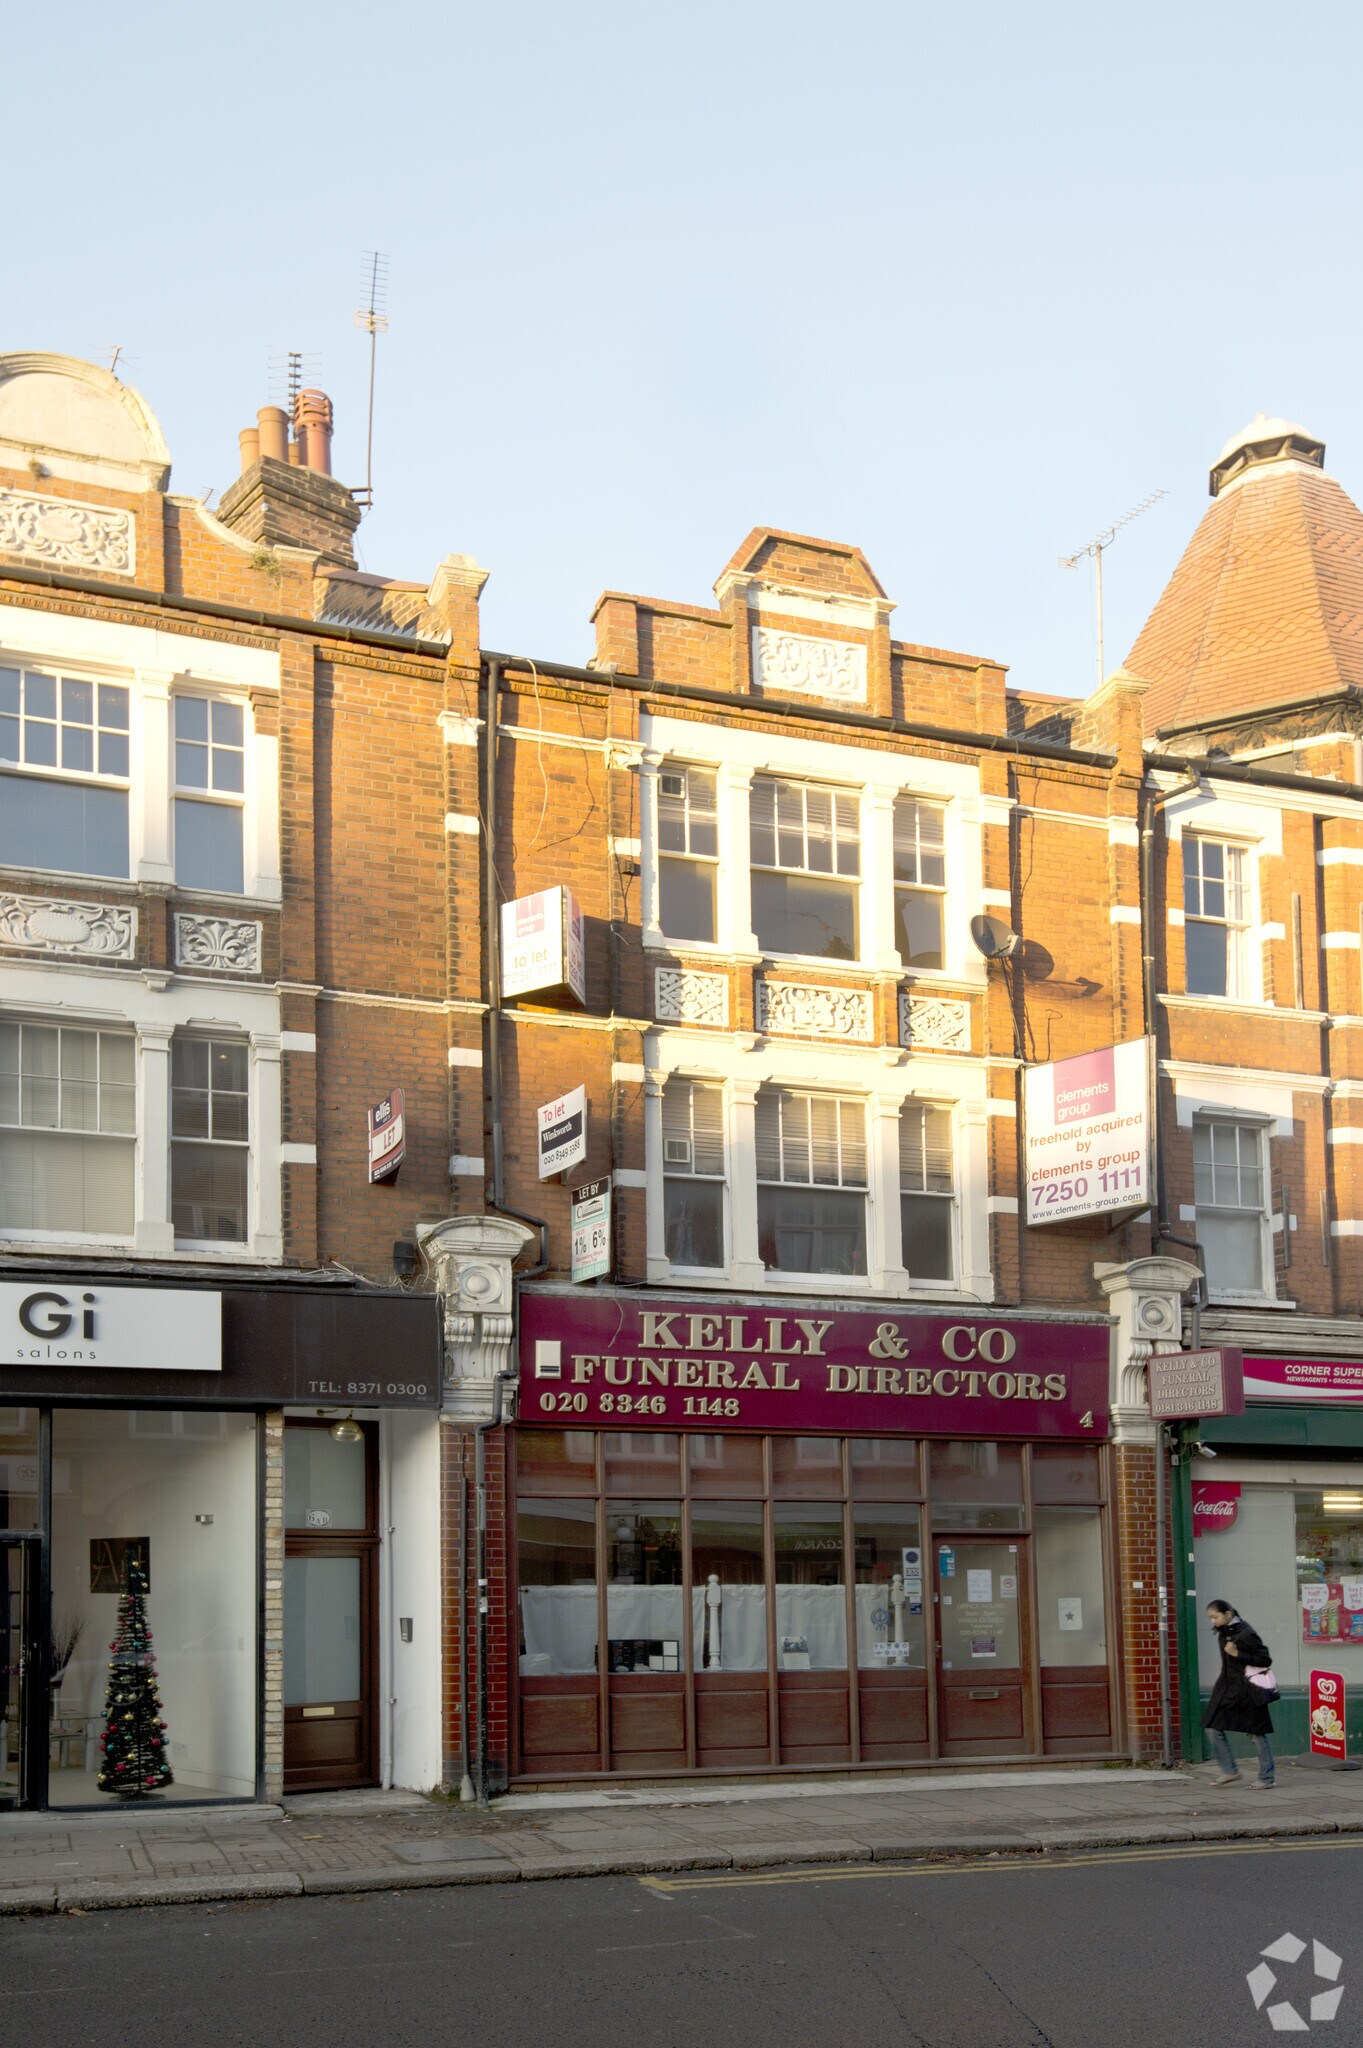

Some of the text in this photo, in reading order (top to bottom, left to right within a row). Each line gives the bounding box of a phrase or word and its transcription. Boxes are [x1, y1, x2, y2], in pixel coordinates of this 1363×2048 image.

[514, 948, 547, 968] to let
[1056, 1081, 1109, 1104] clements
[375, 1100, 391, 1123] ellis
[543, 1101, 565, 1123] To let
[1057, 1102, 1091, 1121] group
[383, 1126, 396, 1150] LET
[542, 1121, 573, 1142] Winkworth
[1030, 1112, 1142, 1148] freehold acquired
[1076, 1140, 1091, 1154] by
[543, 1154, 555, 1165] 020
[1032, 1150, 1140, 1182] clements group
[579, 1182, 599, 1200] LET BY
[1032, 1166, 1141, 1207] 7250 1111
[1032, 1192, 1142, 1220] www.clements-group.com
[574, 1236, 587, 1256] 1%
[592, 1228, 607, 1248] 6%
[18, 1291, 96, 1339] Gi
[638, 1311, 1017, 1365] KELLY & CO
[17, 1344, 96, 1360] salons
[1156, 1355, 1216, 1373] KELLY & CO
[1284, 1365, 1363, 1378] CORNER SUPE
[571, 1354, 1067, 1401] FUNERAL DIRECTORS
[1162, 1371, 1210, 1386] FUNERAL
[1286, 1376, 1328, 1384] NEWSAGENTS
[309, 1381, 427, 1395] TEL: 8371 0300
[1158, 1385, 1216, 1400] DIRECTORS
[539, 1392, 740, 1417] 020 8346 1148
[1155, 1399, 1218, 1414] 0181 346 1148
[1079, 1410, 1094, 1428] 4
